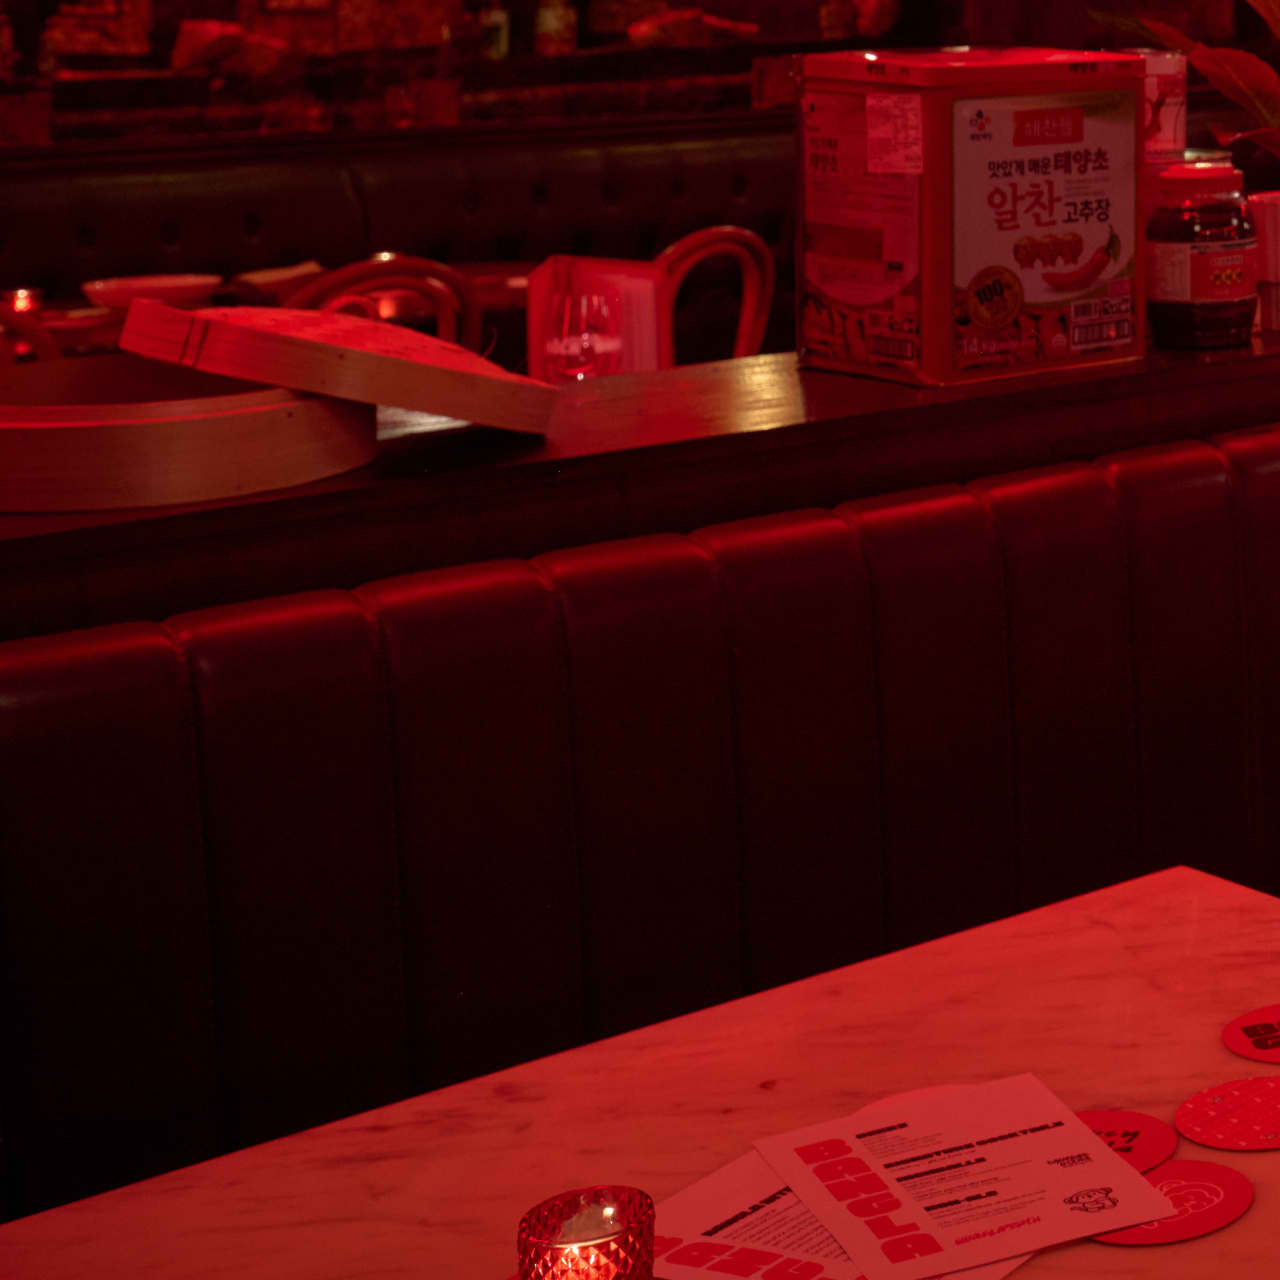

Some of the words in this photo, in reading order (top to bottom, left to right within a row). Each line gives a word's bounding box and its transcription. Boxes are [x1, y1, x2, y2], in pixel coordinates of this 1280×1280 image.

[1053, 147, 1109, 175] 태양초
[987, 178, 1061, 231] 알찬
[1062, 198, 1111, 223] 고추장
[793, 1137, 945, 1265] BANGLA
